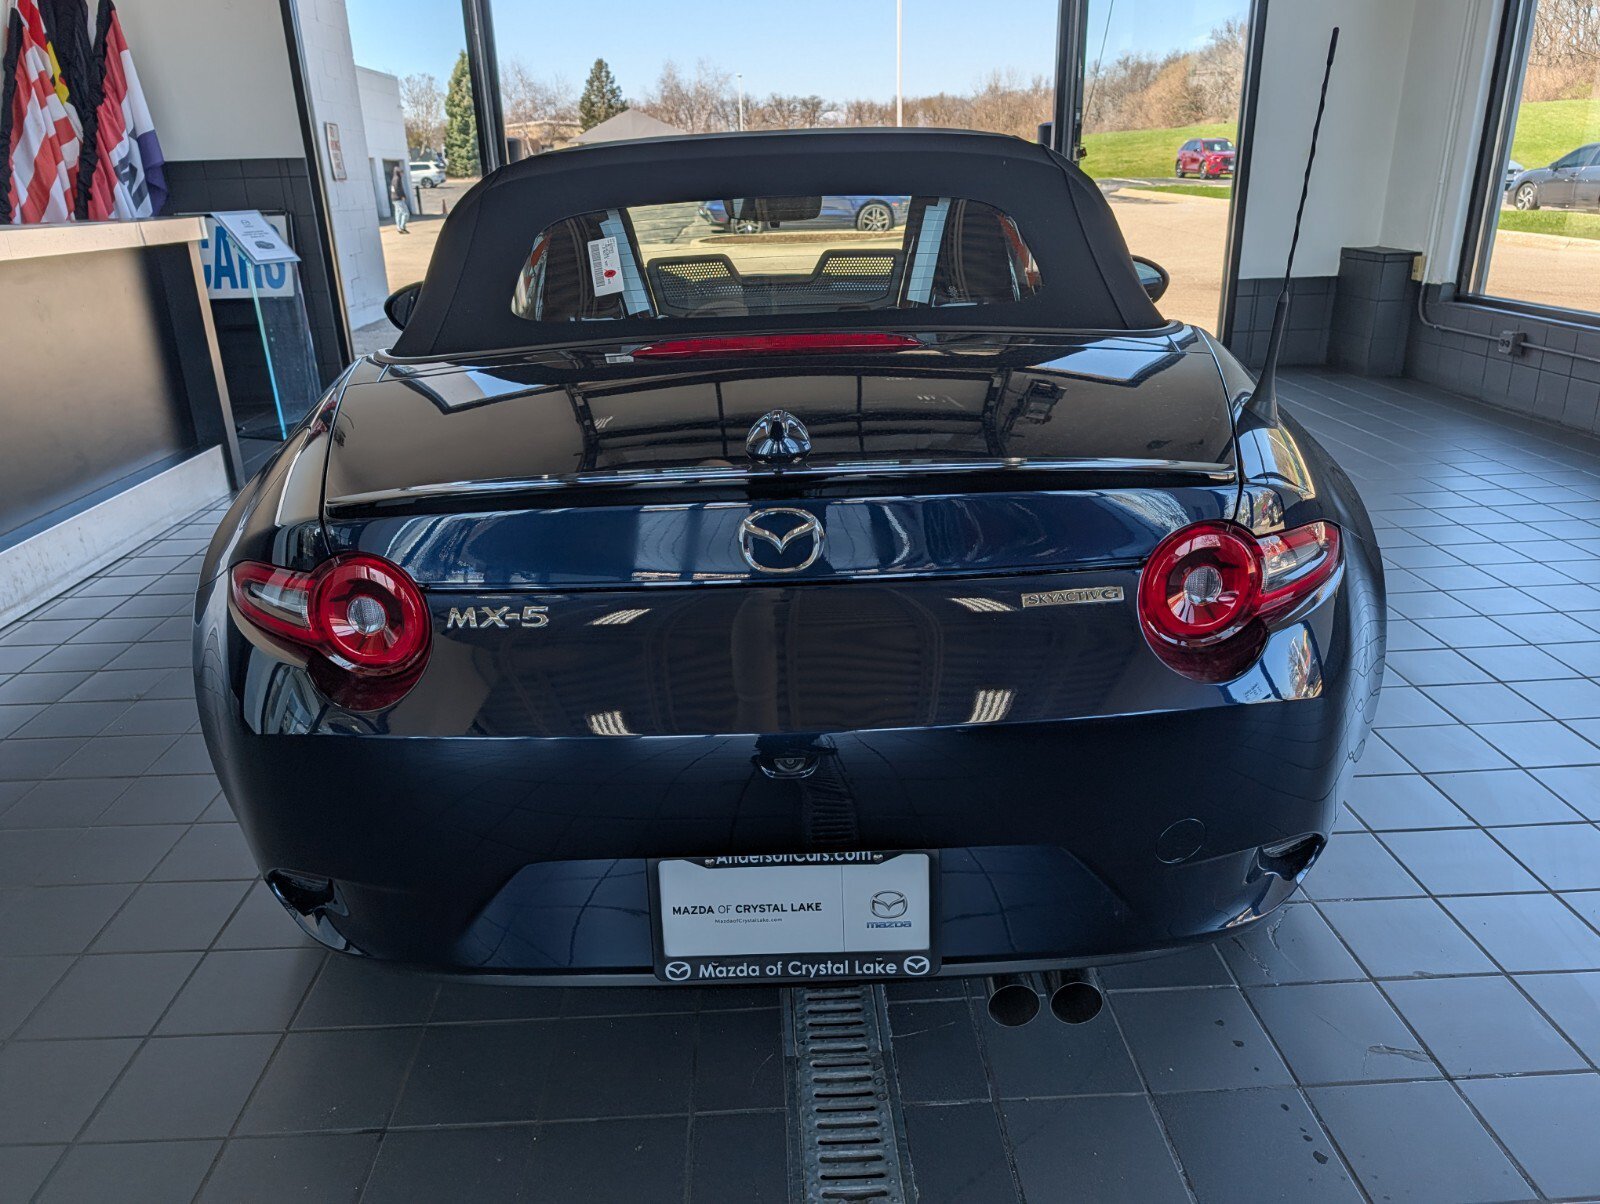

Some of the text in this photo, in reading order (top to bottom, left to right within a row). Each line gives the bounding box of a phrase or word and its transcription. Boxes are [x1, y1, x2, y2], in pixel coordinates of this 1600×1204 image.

[446, 605, 549, 629] MX-5
[672, 902, 823, 916] MAZDA OF CRYSTAL LAKE
[698, 960, 898, 979] Mazda of Crystal Lake
